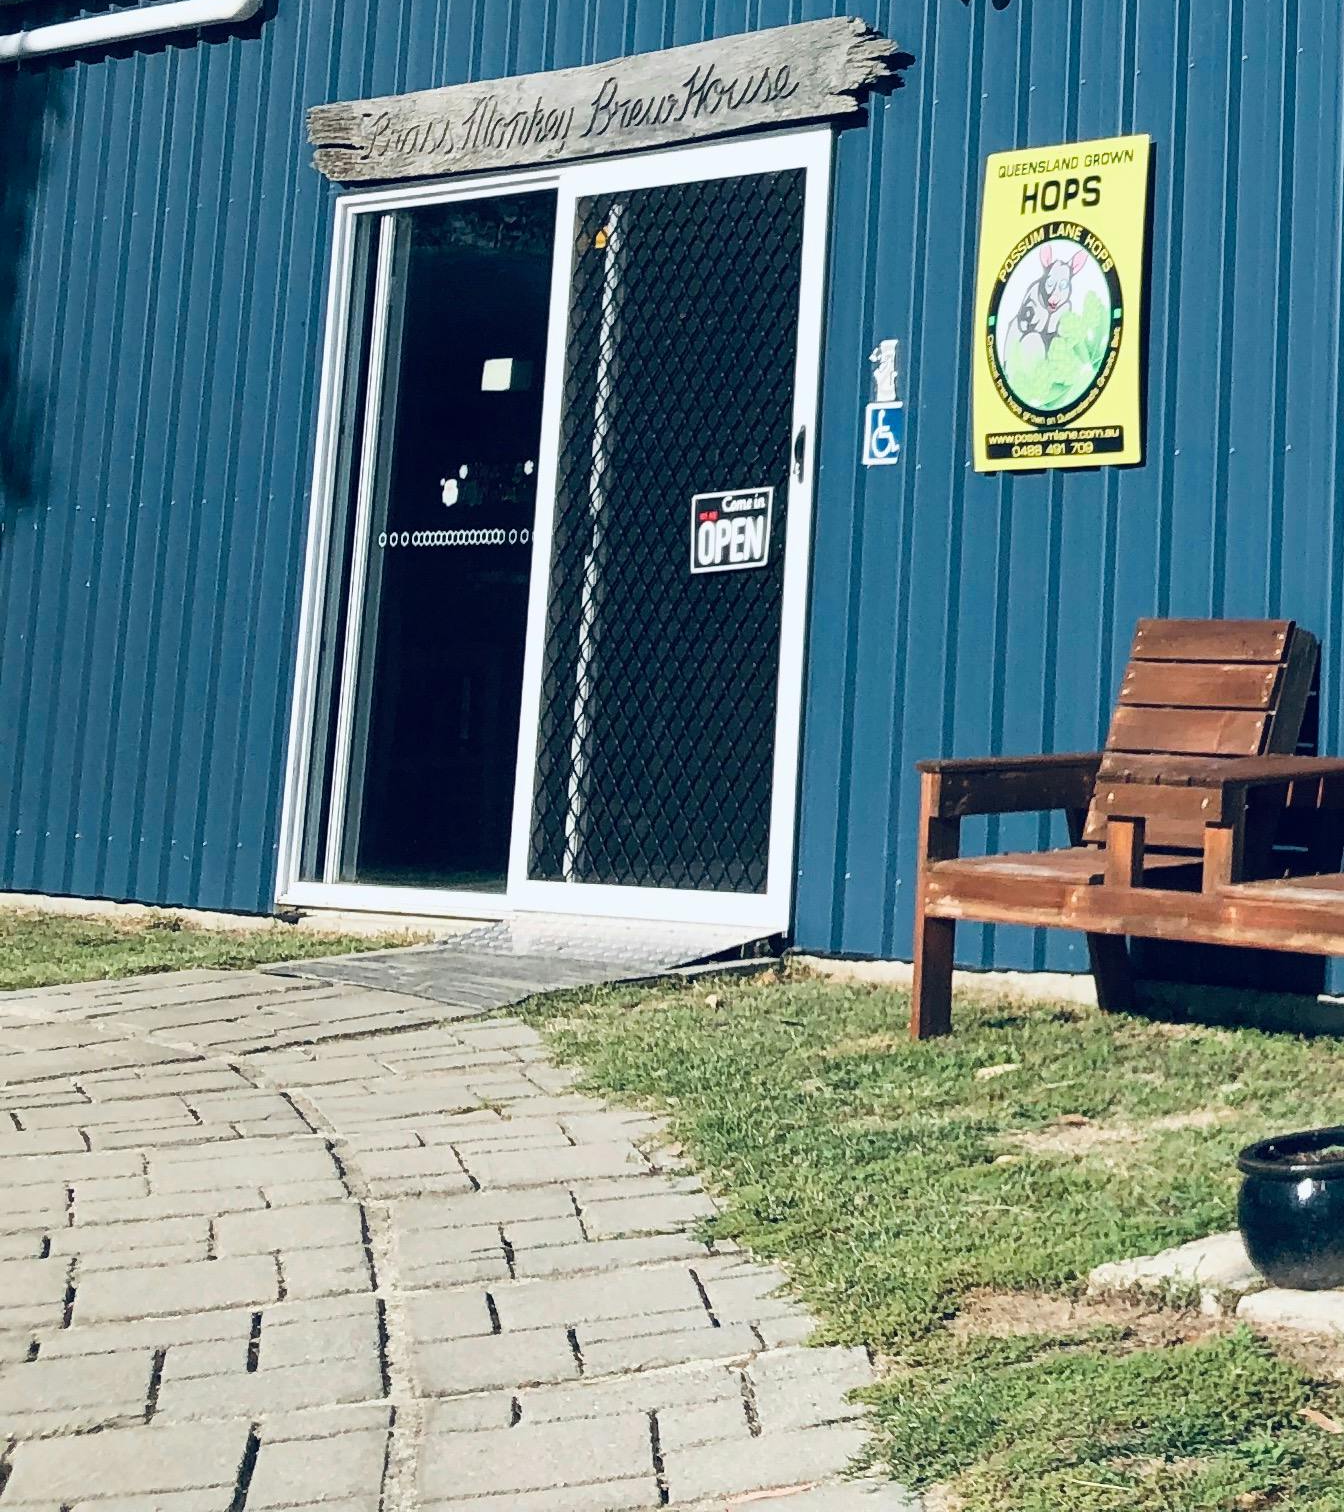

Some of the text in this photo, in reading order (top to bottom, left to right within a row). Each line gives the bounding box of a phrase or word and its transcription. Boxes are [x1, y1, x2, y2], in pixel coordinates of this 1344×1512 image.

[360, 111, 453, 160] Brass
[462, 95, 574, 153] Monkey
[998, 149, 1134, 178] QUEENSLAND GROWN
[1020, 175, 1102, 215] HOPS
[998, 222, 1114, 283] POSSUM LANE HOPS
[722, 493, 766, 513] Come in
[697, 514, 764, 565] OPEN
